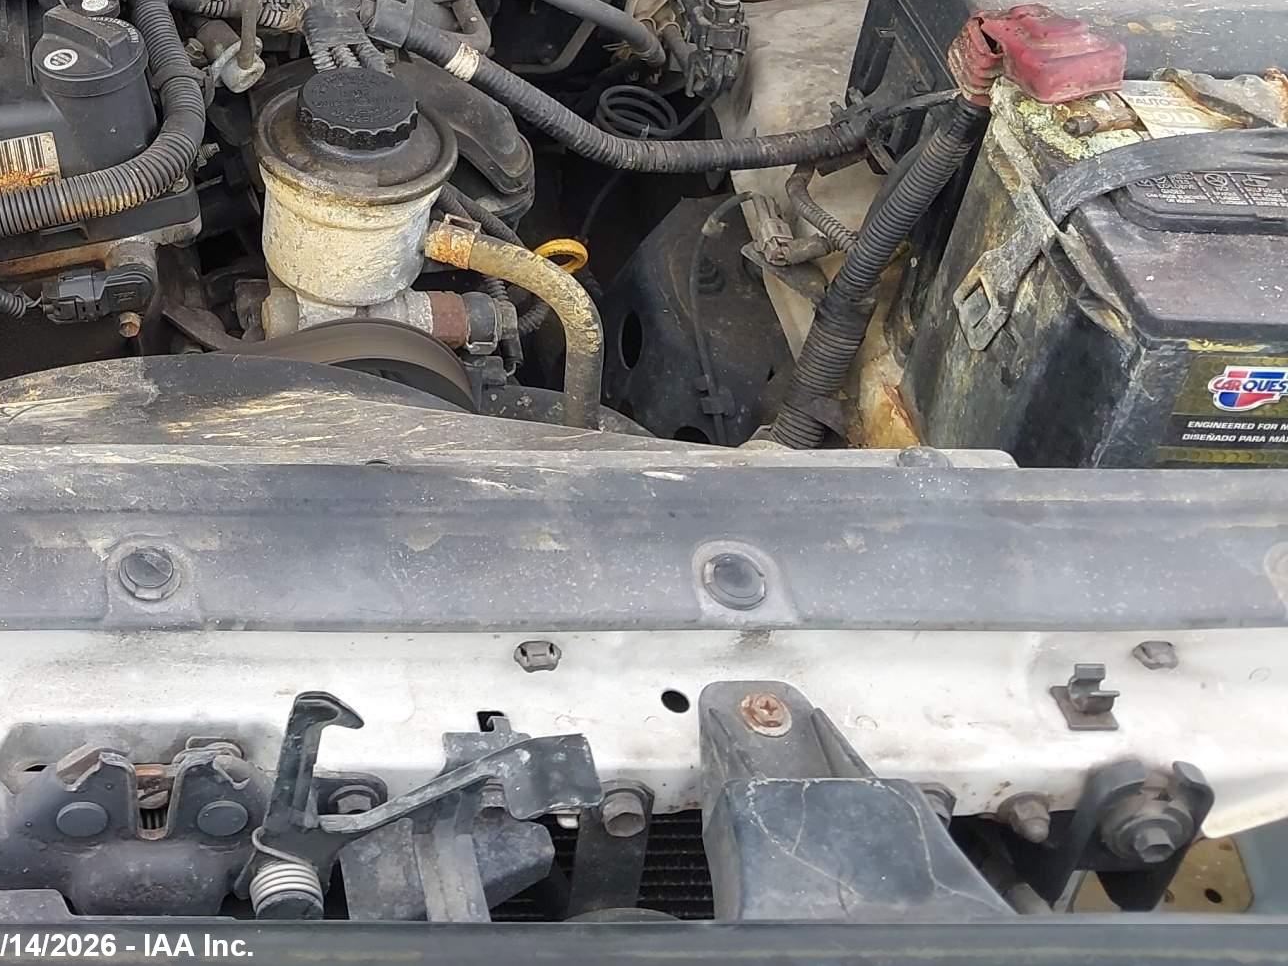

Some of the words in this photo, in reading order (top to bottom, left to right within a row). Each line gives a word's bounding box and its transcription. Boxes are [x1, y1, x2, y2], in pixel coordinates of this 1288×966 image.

[1213, 378, 1288, 392] CARQUES
[1187, 421, 1256, 430] ENGINEERED
[1257, 423, 1277, 431] FOR
[1182, 432, 1237, 442] DISEÑADO
[1238, 435, 1267, 443] PARA
